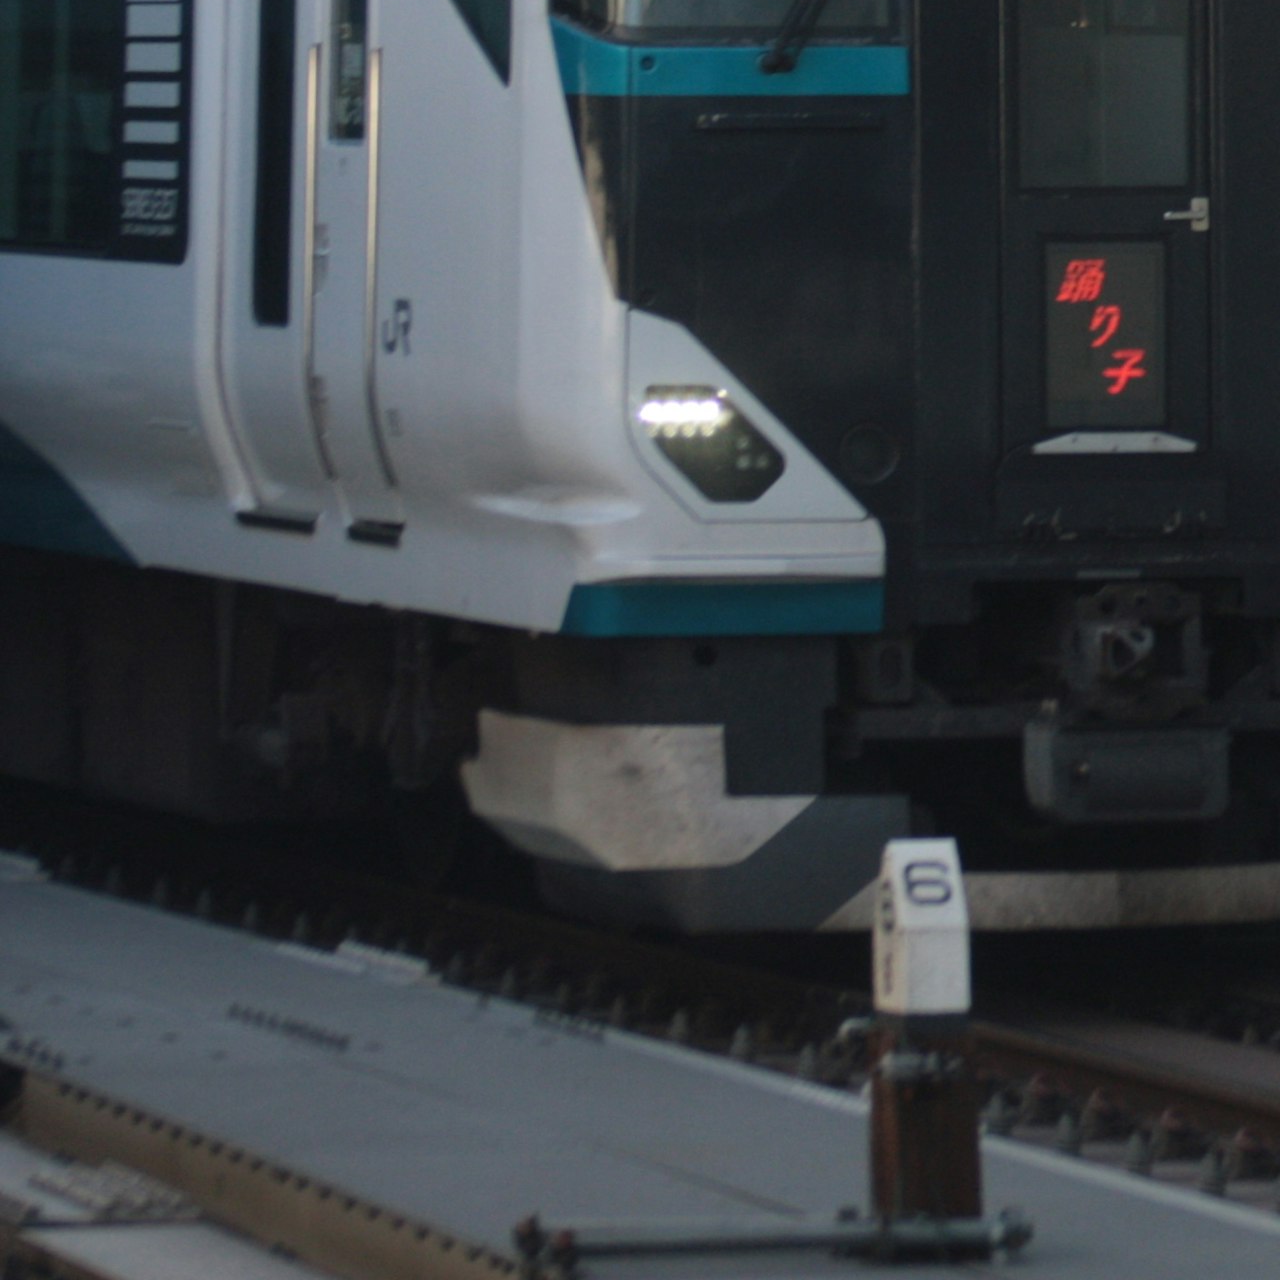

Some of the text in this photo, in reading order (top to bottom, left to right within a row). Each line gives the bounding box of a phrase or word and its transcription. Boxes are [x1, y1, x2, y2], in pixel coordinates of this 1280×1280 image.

[382, 298, 413, 357] JR
[1055, 257, 1147, 395] 踊り子
[905, 862, 952, 905] 6
